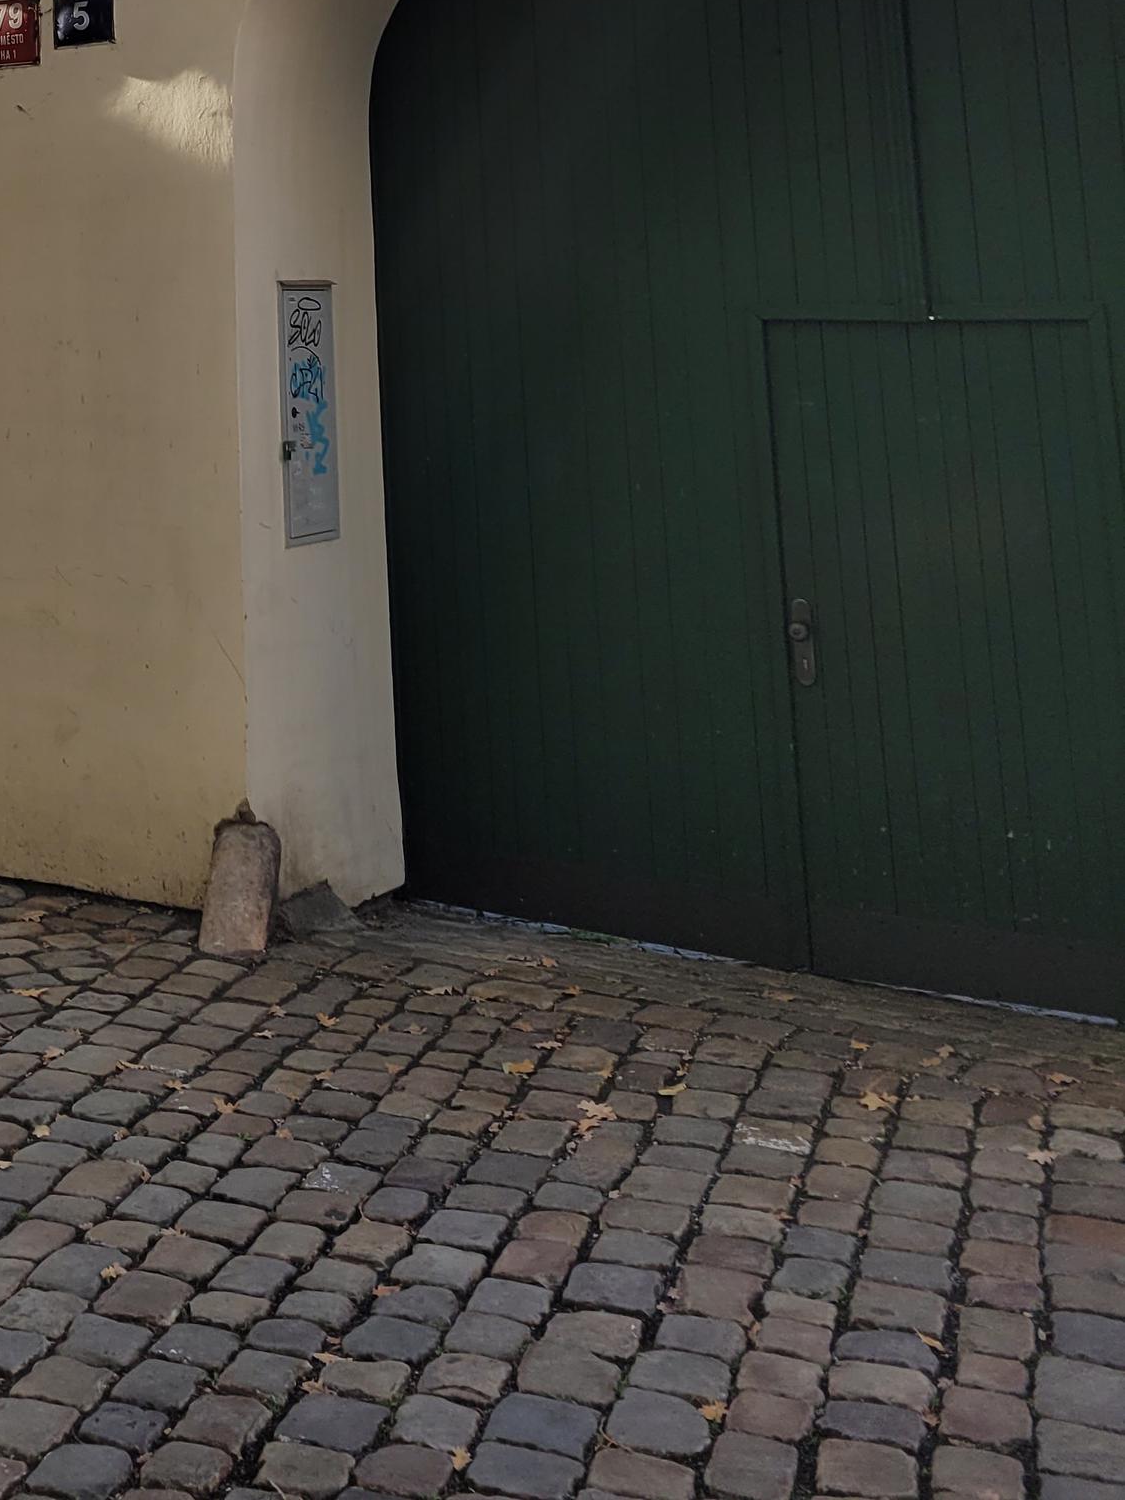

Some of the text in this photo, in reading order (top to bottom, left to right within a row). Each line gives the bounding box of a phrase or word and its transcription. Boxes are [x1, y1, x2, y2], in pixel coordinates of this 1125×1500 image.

[73, 0, 90, 31] 5
[0, 31, 24, 46] MĚSTO
[12, 49, 17, 59] 1
